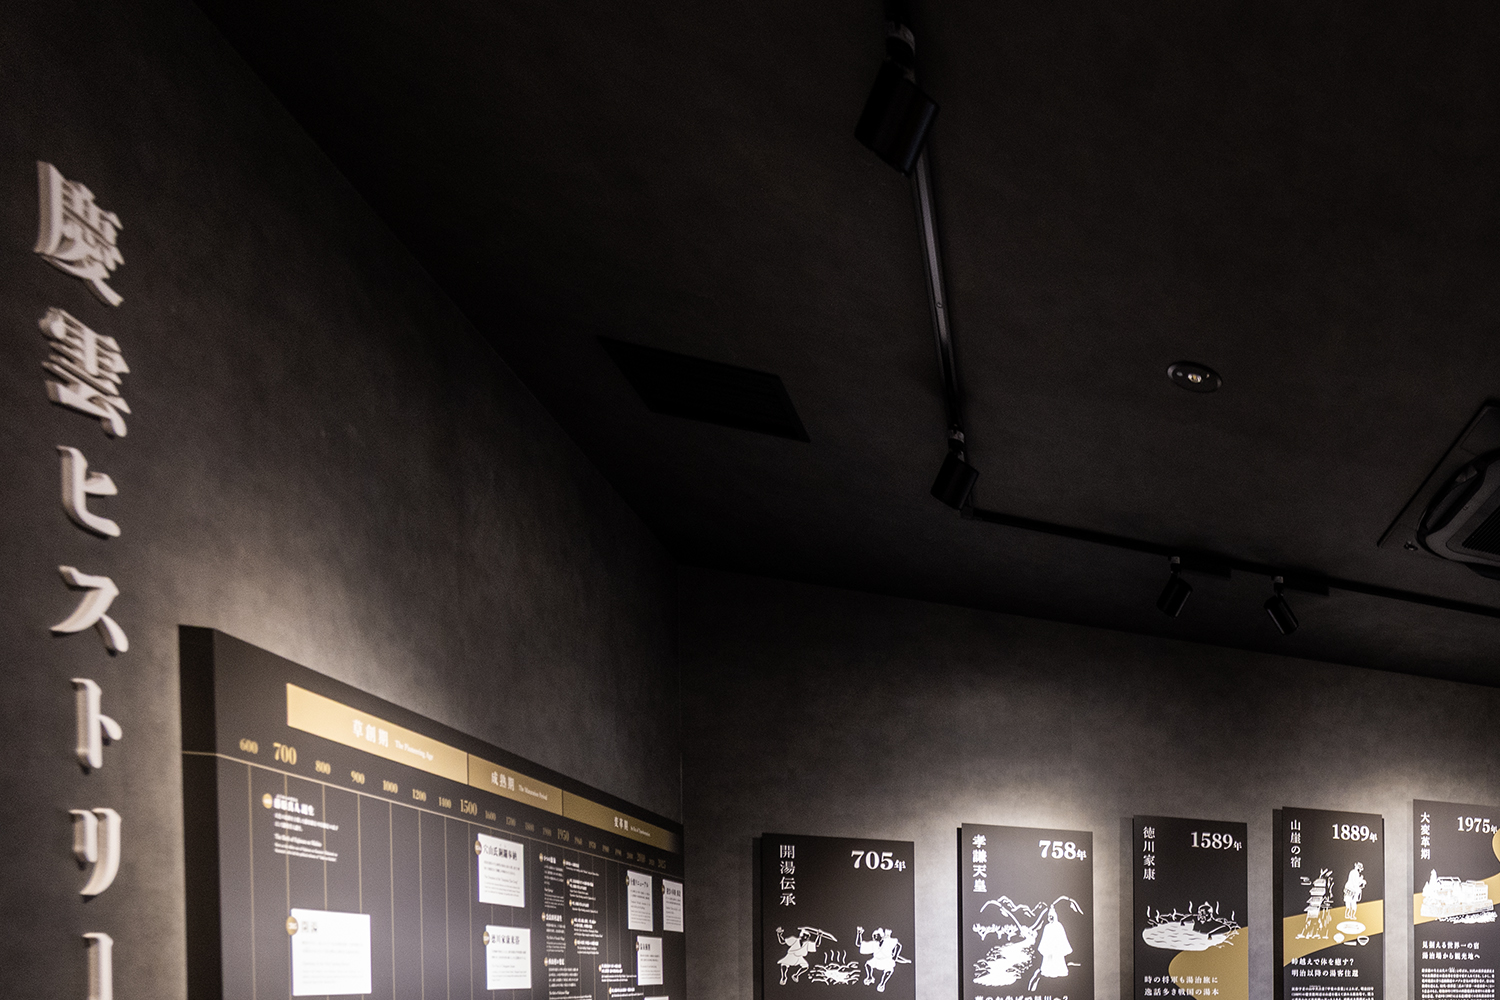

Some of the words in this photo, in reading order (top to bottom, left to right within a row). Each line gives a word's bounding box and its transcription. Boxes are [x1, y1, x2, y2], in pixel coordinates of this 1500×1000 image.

[352, 718, 389, 748] 草創期
[240, 738, 258, 754] 600
[273, 742, 297, 765] 700
[315, 760, 331, 775] 800
[350, 770, 365, 784] 900
[382, 780, 398, 794] 1000
[412, 788, 426, 802] 1200
[460, 798, 478, 816] 1500
[490, 770, 515, 792] 成熟期
[1332, 824, 1378, 843] 1889年
[1457, 816, 1498, 834] 1975年
[1038, 840, 1087, 862] 758年
[1190, 831, 1243, 852] 1589年
[850, 850, 906, 872] 705年
[972, 834, 988, 893] 孝謙天皇
[1142, 826, 1156, 881] 徳川家康
[779, 844, 796, 907] 開湯伝承
